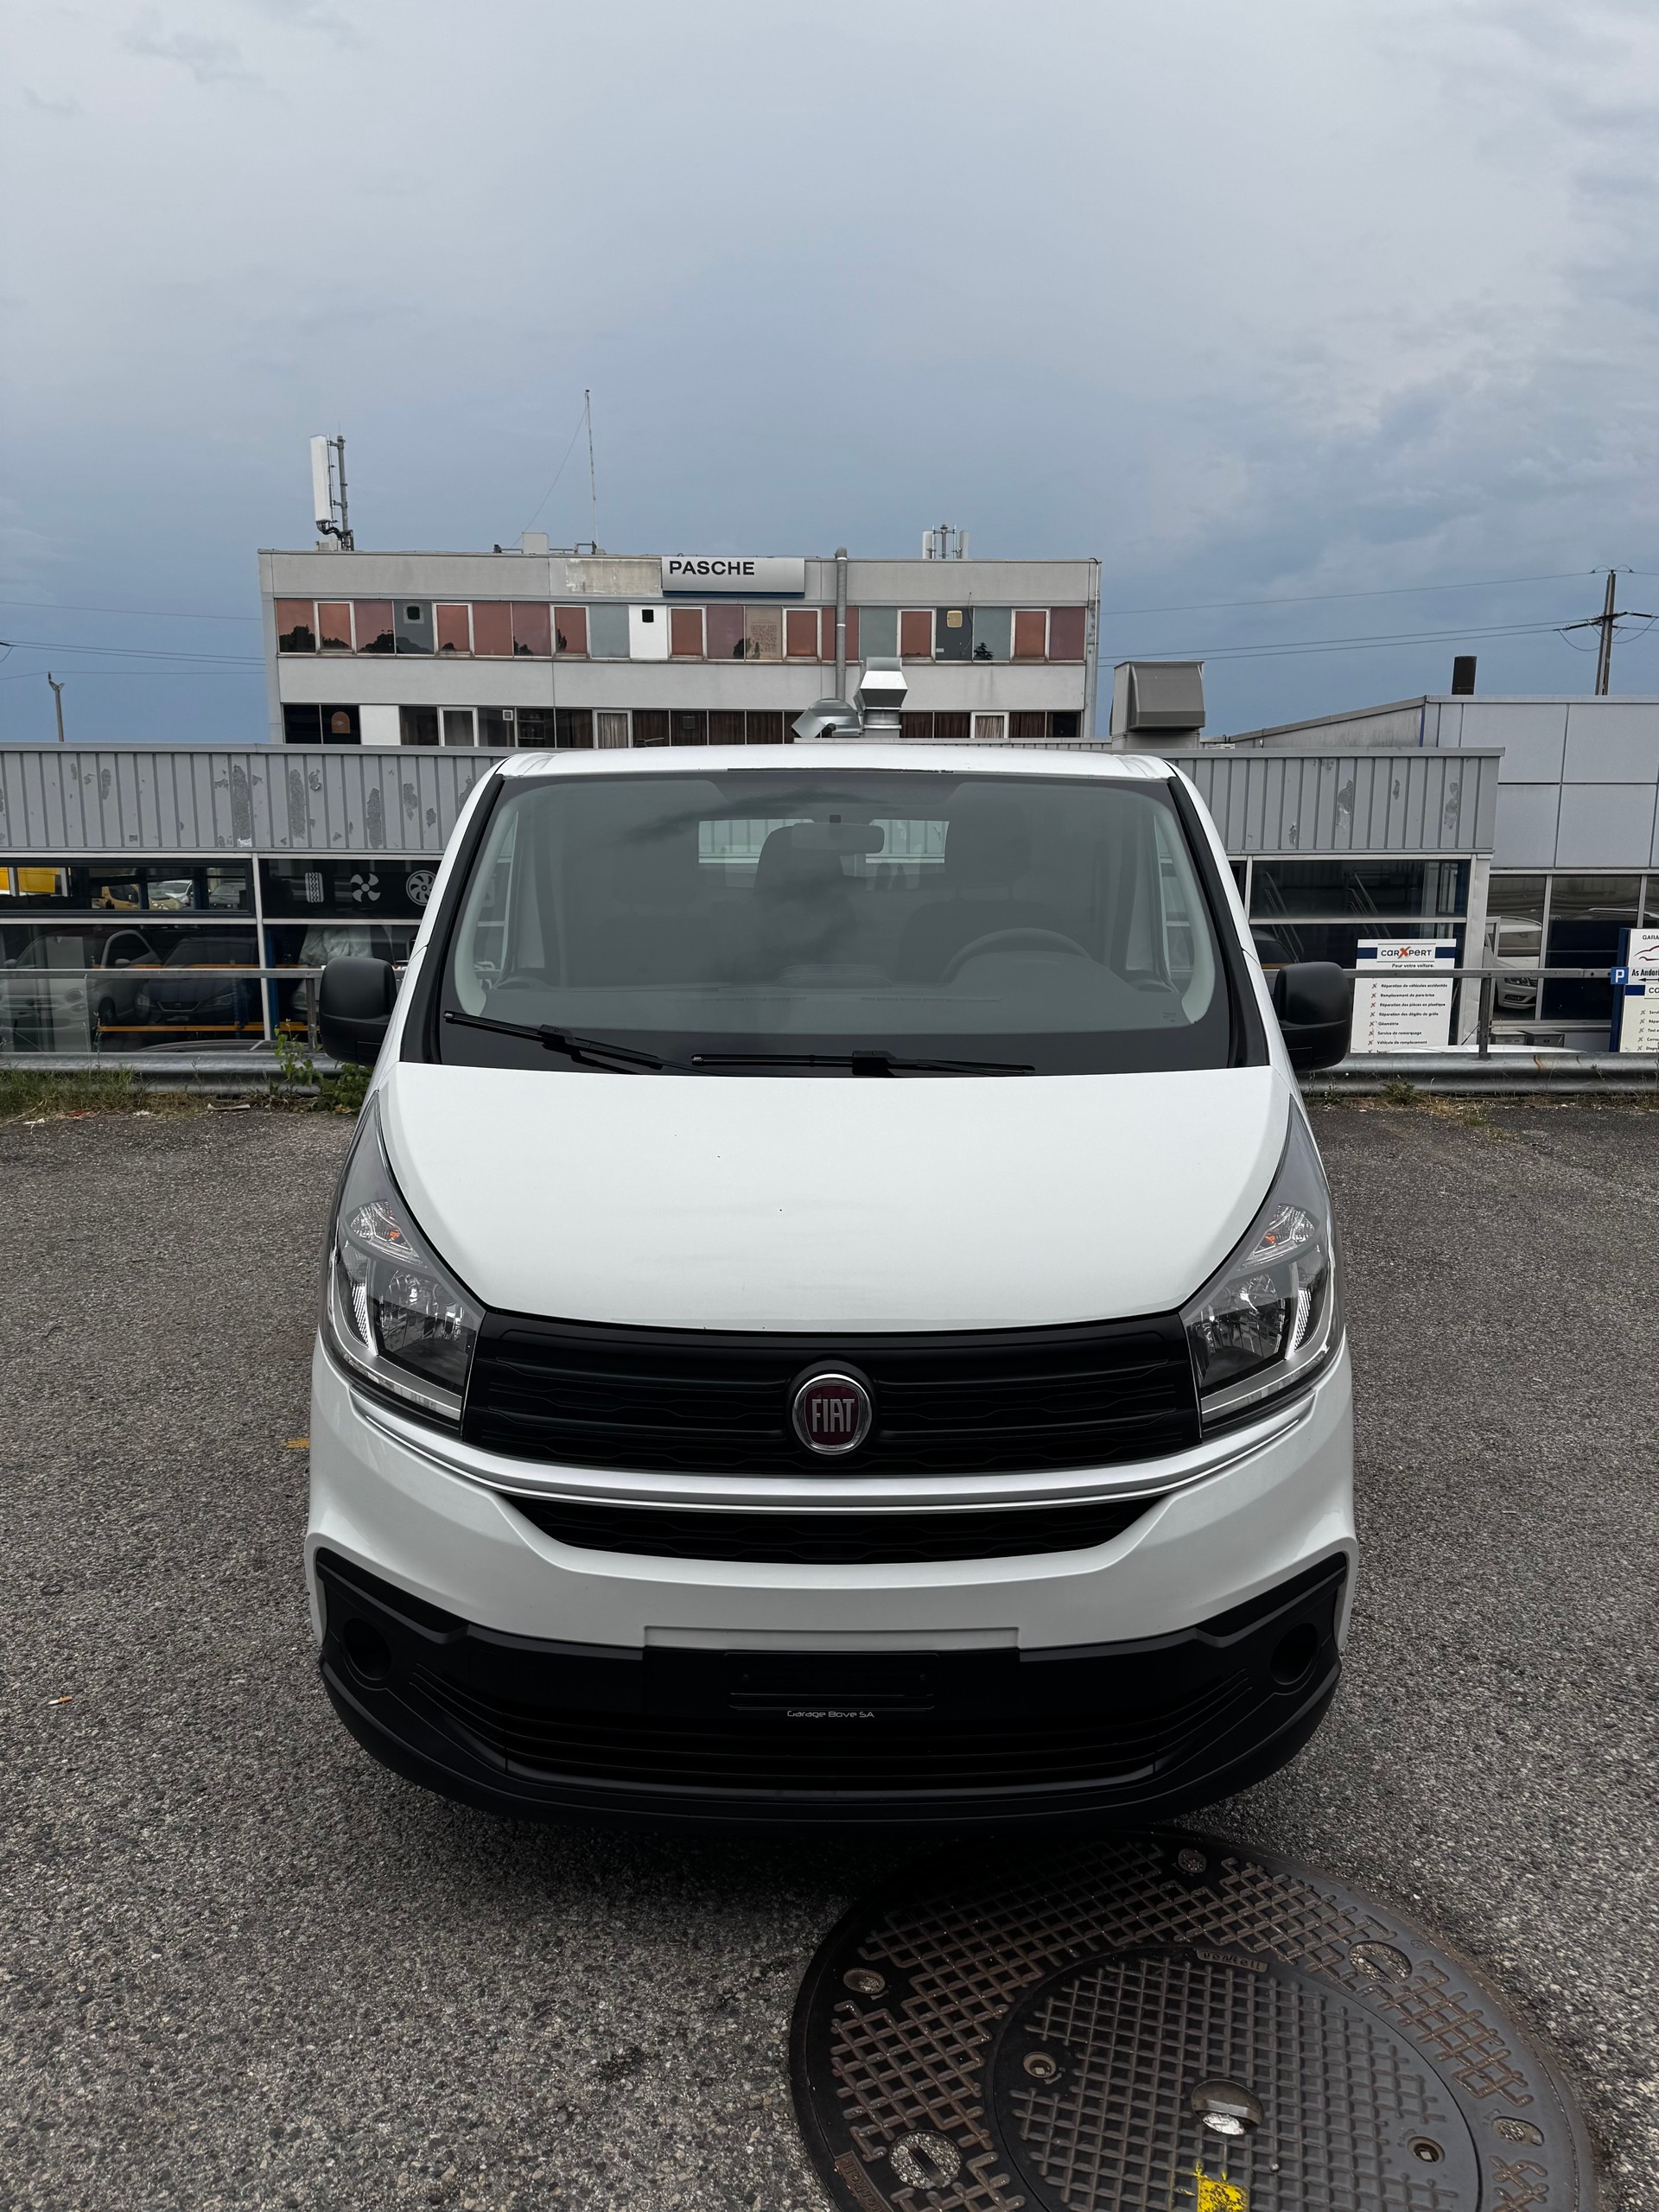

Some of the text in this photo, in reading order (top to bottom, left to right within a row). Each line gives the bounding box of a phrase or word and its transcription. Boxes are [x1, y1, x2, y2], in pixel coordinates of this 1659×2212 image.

[669, 561, 755, 575] PASCHE
[1615, 969, 1624, 983] P
[811, 1398, 855, 1433] FIAT
